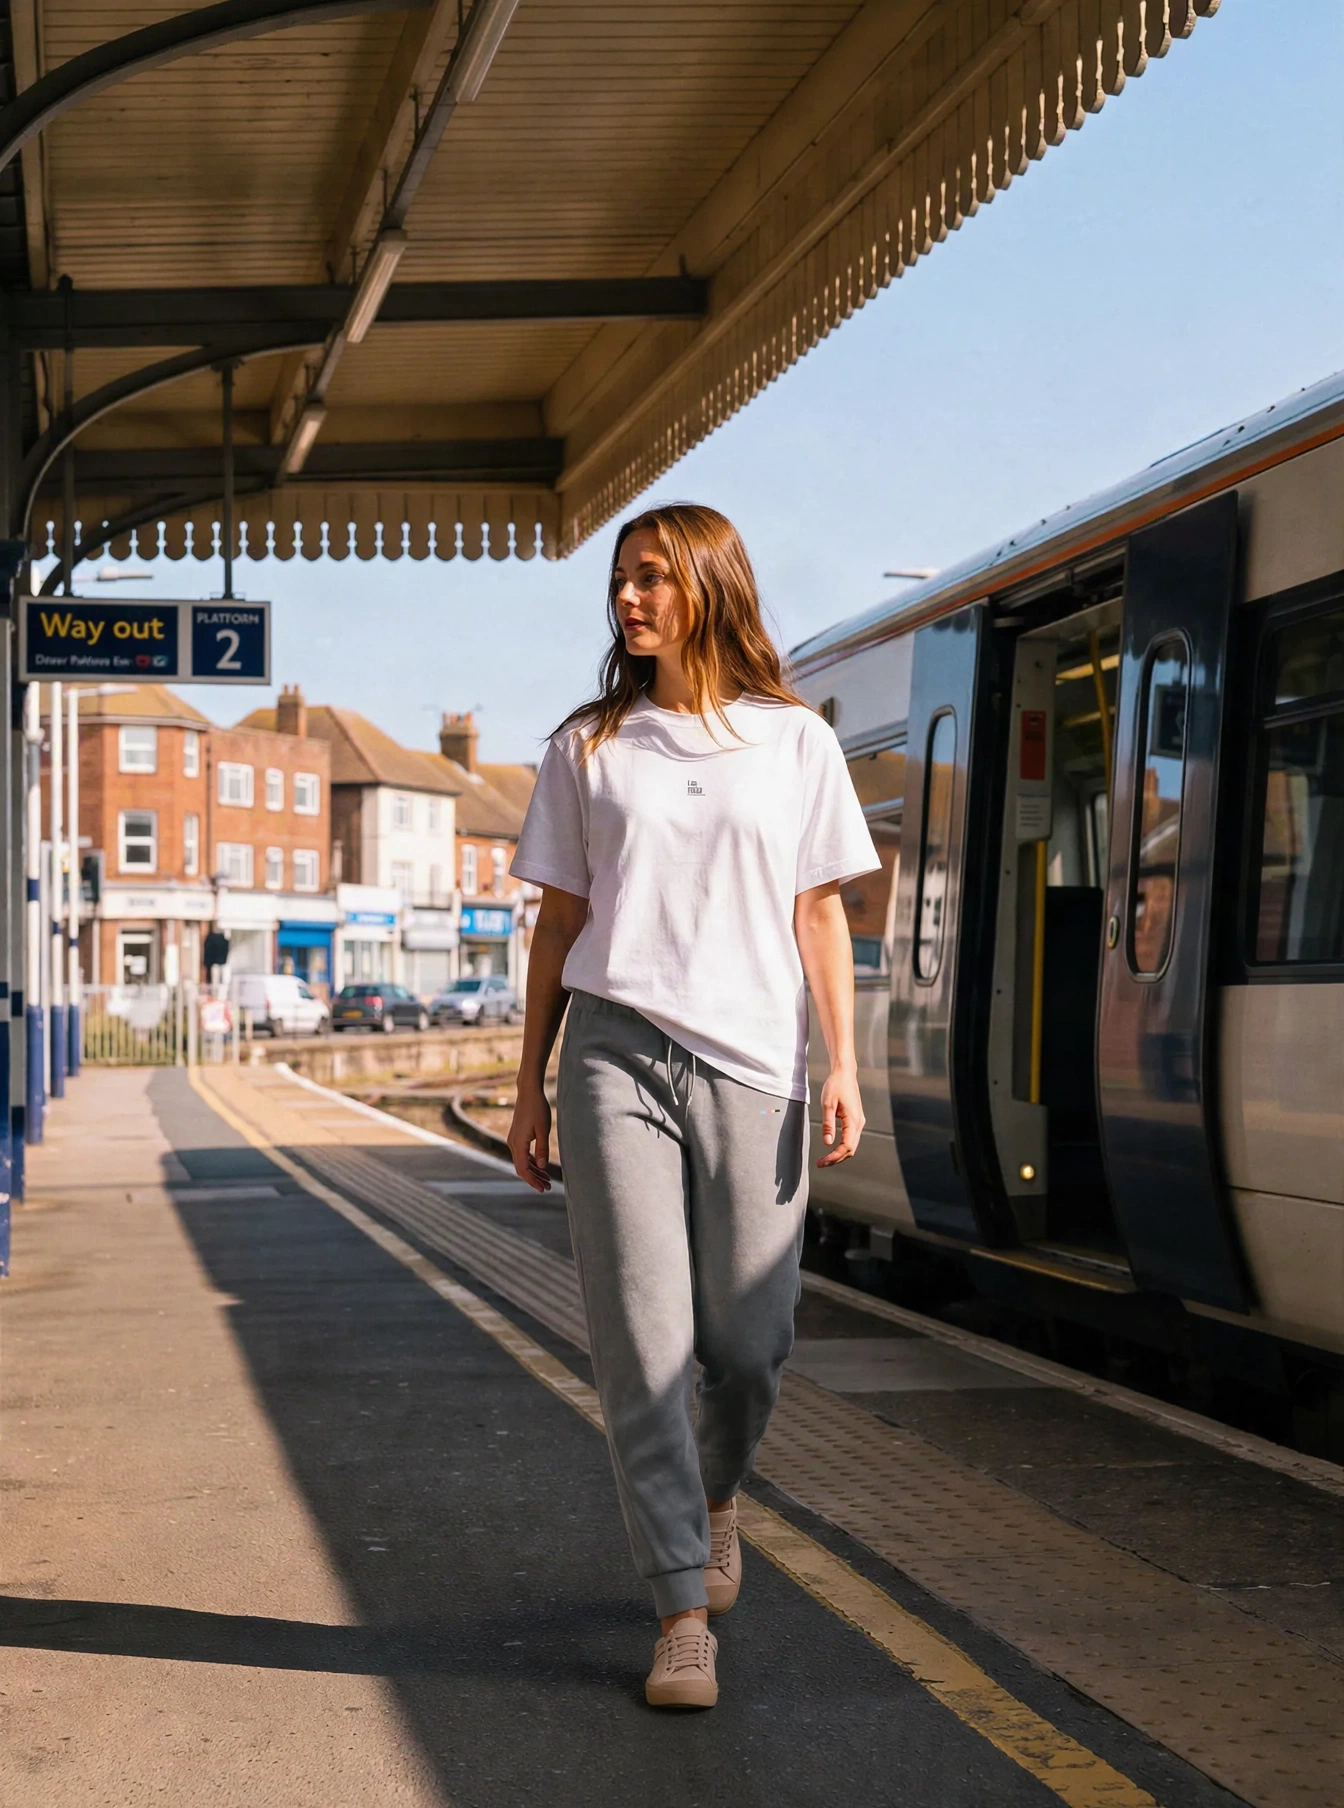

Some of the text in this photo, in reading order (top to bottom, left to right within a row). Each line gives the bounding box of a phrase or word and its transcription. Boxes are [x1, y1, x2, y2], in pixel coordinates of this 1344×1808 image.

[40, 612, 165, 645] Way out
[215, 629, 242, 670] 2
